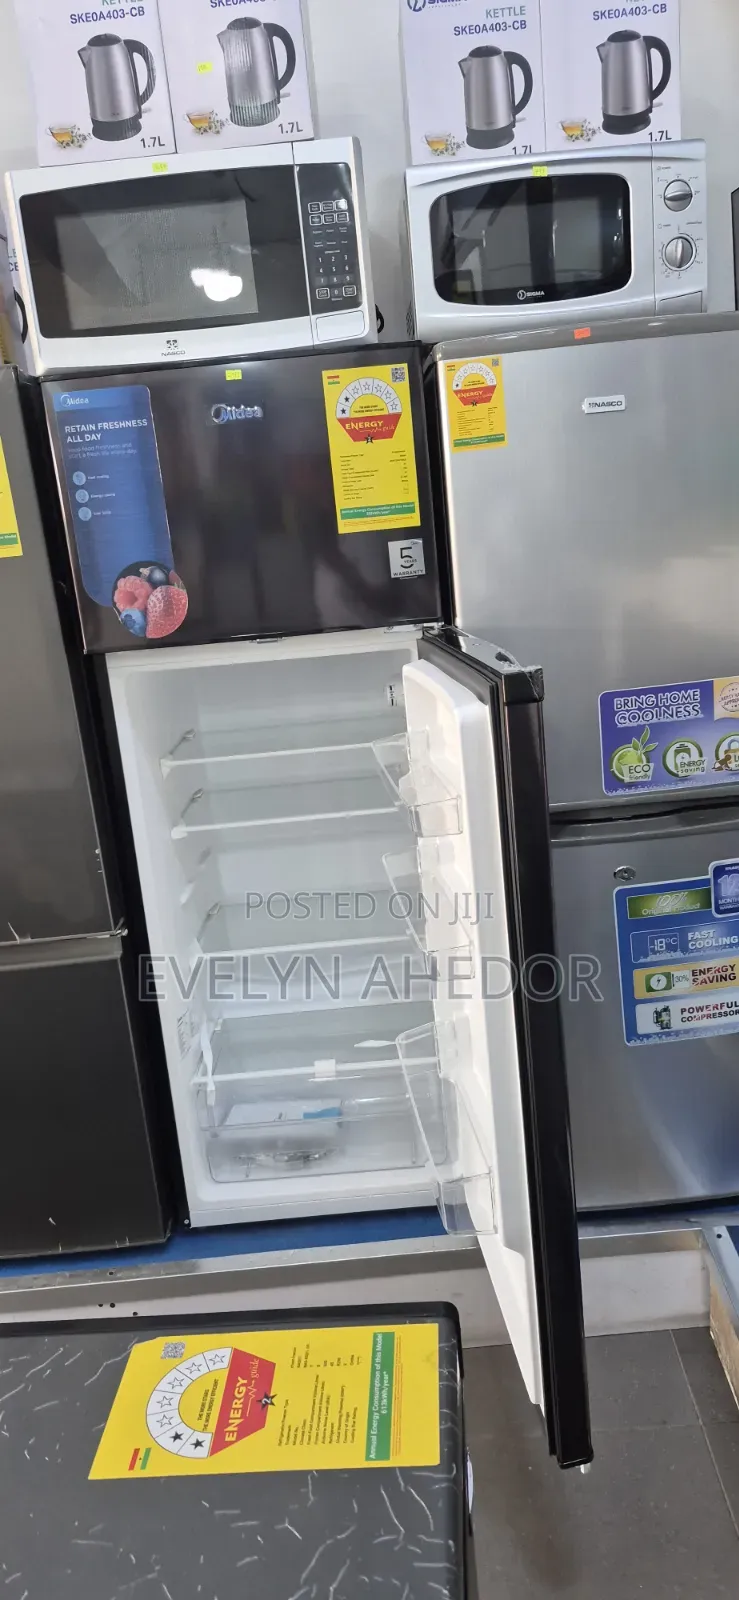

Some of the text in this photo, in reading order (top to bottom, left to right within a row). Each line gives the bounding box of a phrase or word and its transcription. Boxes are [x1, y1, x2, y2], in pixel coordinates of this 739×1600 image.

[69, 5, 145, 24] SKE0A403-CB
[486, 5, 526, 19] KETTLE
[592, 3, 667, 21] SKE0A403-CB
[453, 19, 527, 36] SKE0A403-CB
[278, 121, 304, 135] 1.7L
[648, 129, 672, 142] 1.7L
[140, 136, 166, 149] 1.7L
[594, 400, 623, 408] NASCO
[211, 403, 264, 424] Midea
[64, 418, 148, 434] RETAIN FRESHNESS
[345, 420, 384, 431] ENERGY
[66, 432, 102, 443] ALL DAY
[400, 546, 414, 569] 5
[393, 569, 424, 577] WARRANTY
[614, 695, 656, 711] BRING
[658, 688, 701, 706] HOME
[615, 703, 702, 725] COOLNESS
[628, 763, 652, 775] ECO
[679, 759, 706, 769] ENERGY
[680, 766, 707, 775] saving
[688, 929, 716, 941] FAST
[688, 935, 739, 950] COOLING
[691, 964, 737, 978] ENERGY
[691, 972, 737, 987] SAVING
[680, 1001, 739, 1016] POWERFUL
[250, 1358, 260, 1378] guide
[373, 1370, 381, 1410] Consumption
[224, 1376, 248, 1441] ENERGY
[371, 1412, 379, 1434] Energy
[369, 1435, 377, 1459] Annual
